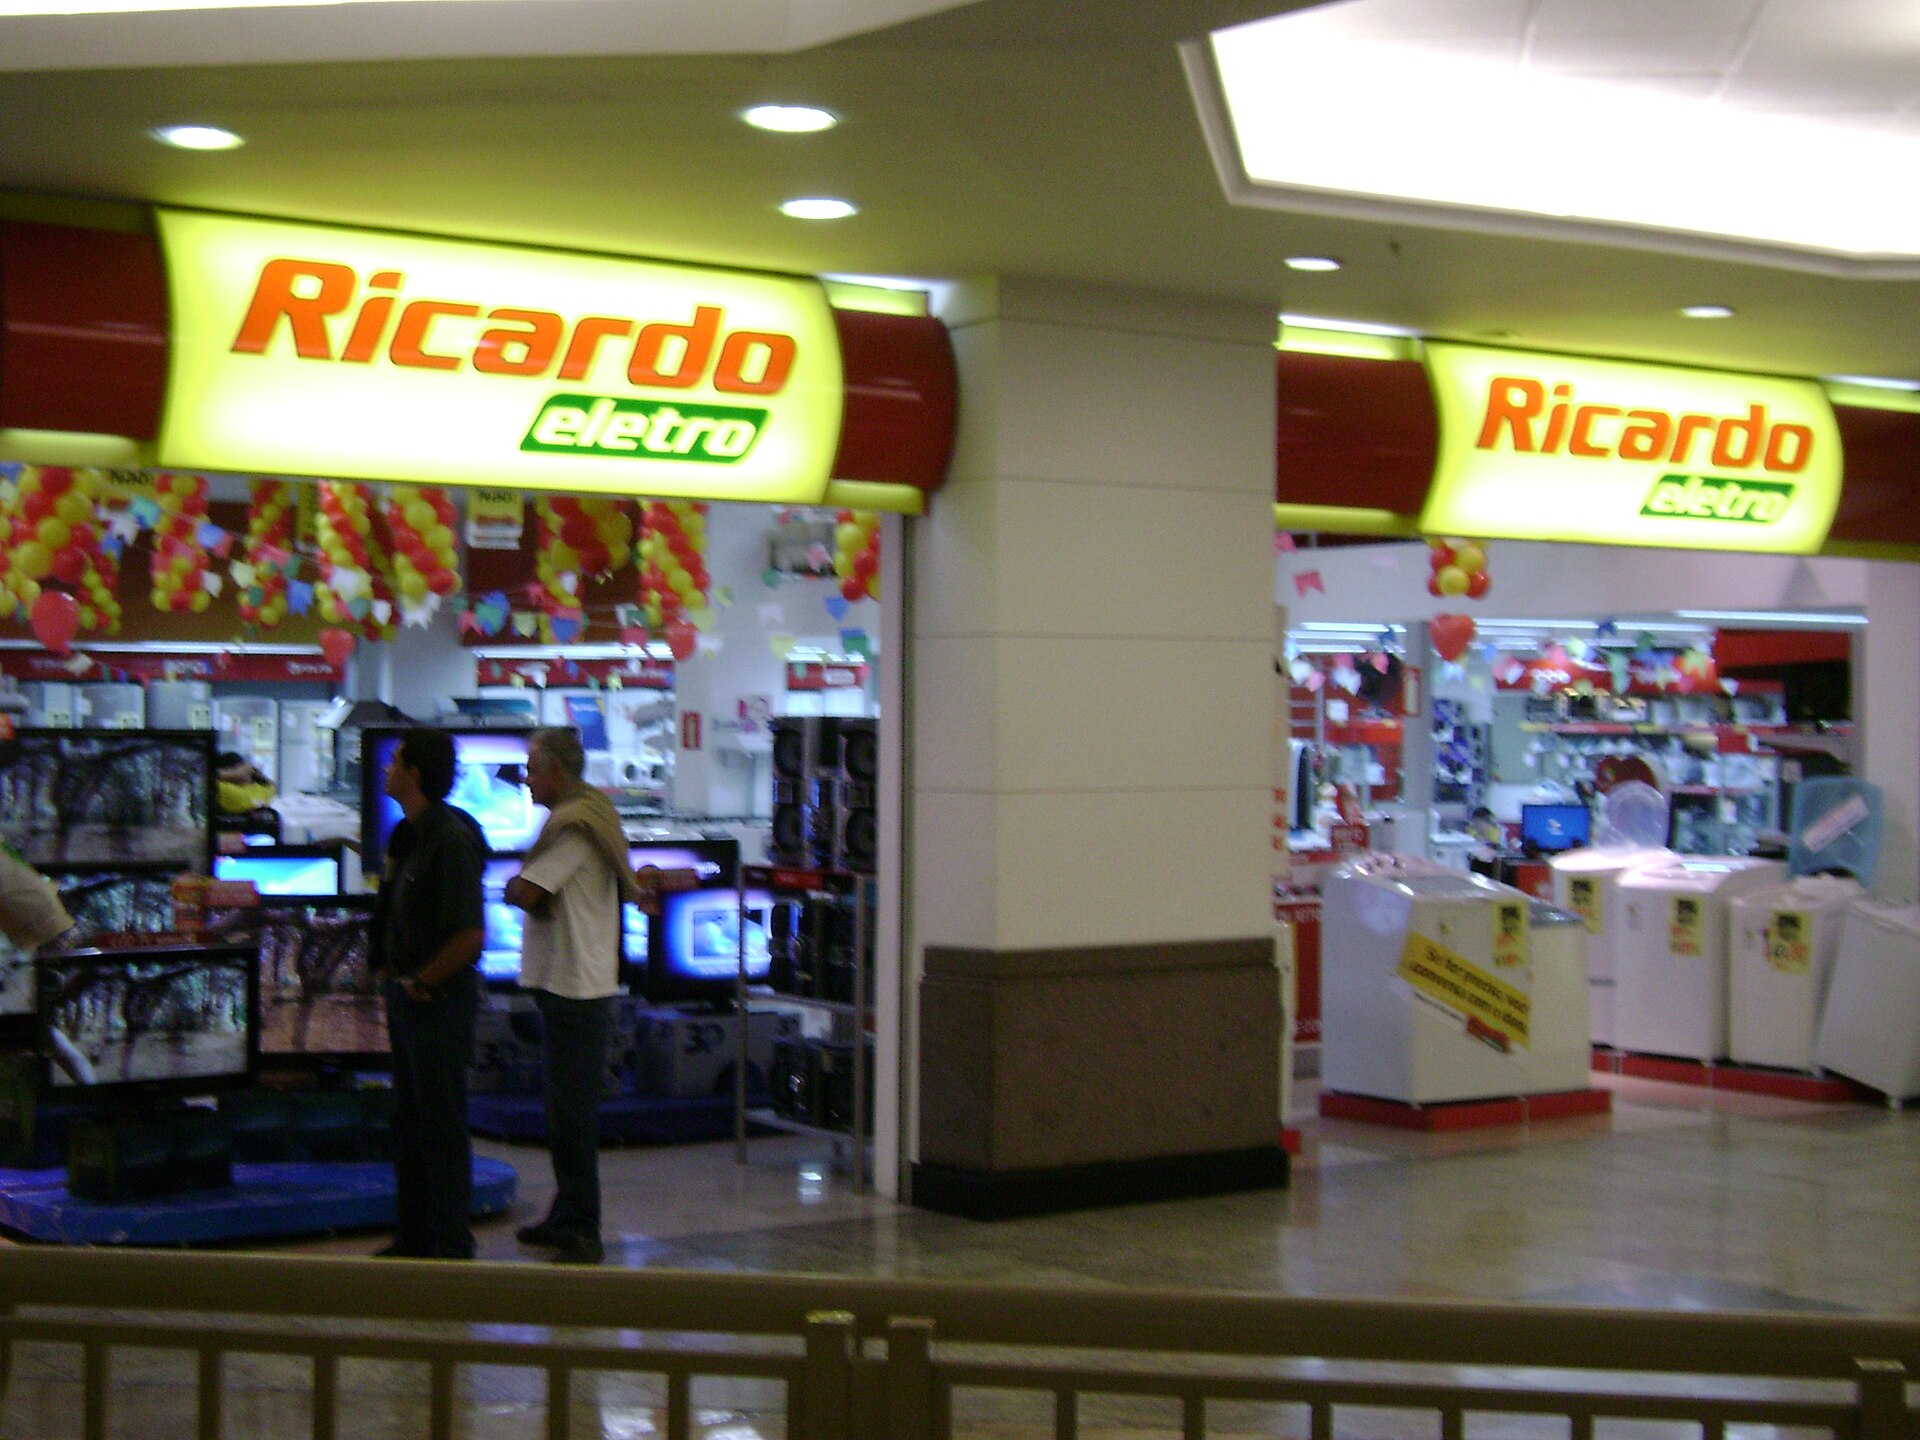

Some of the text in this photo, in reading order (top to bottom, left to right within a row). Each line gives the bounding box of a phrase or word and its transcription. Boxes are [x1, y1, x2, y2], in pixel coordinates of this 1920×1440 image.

[230, 258, 796, 395] Ricardo
[531, 397, 757, 458] eletro
[1476, 377, 1813, 472] Ricardo
[1649, 475, 1788, 521] eletro
